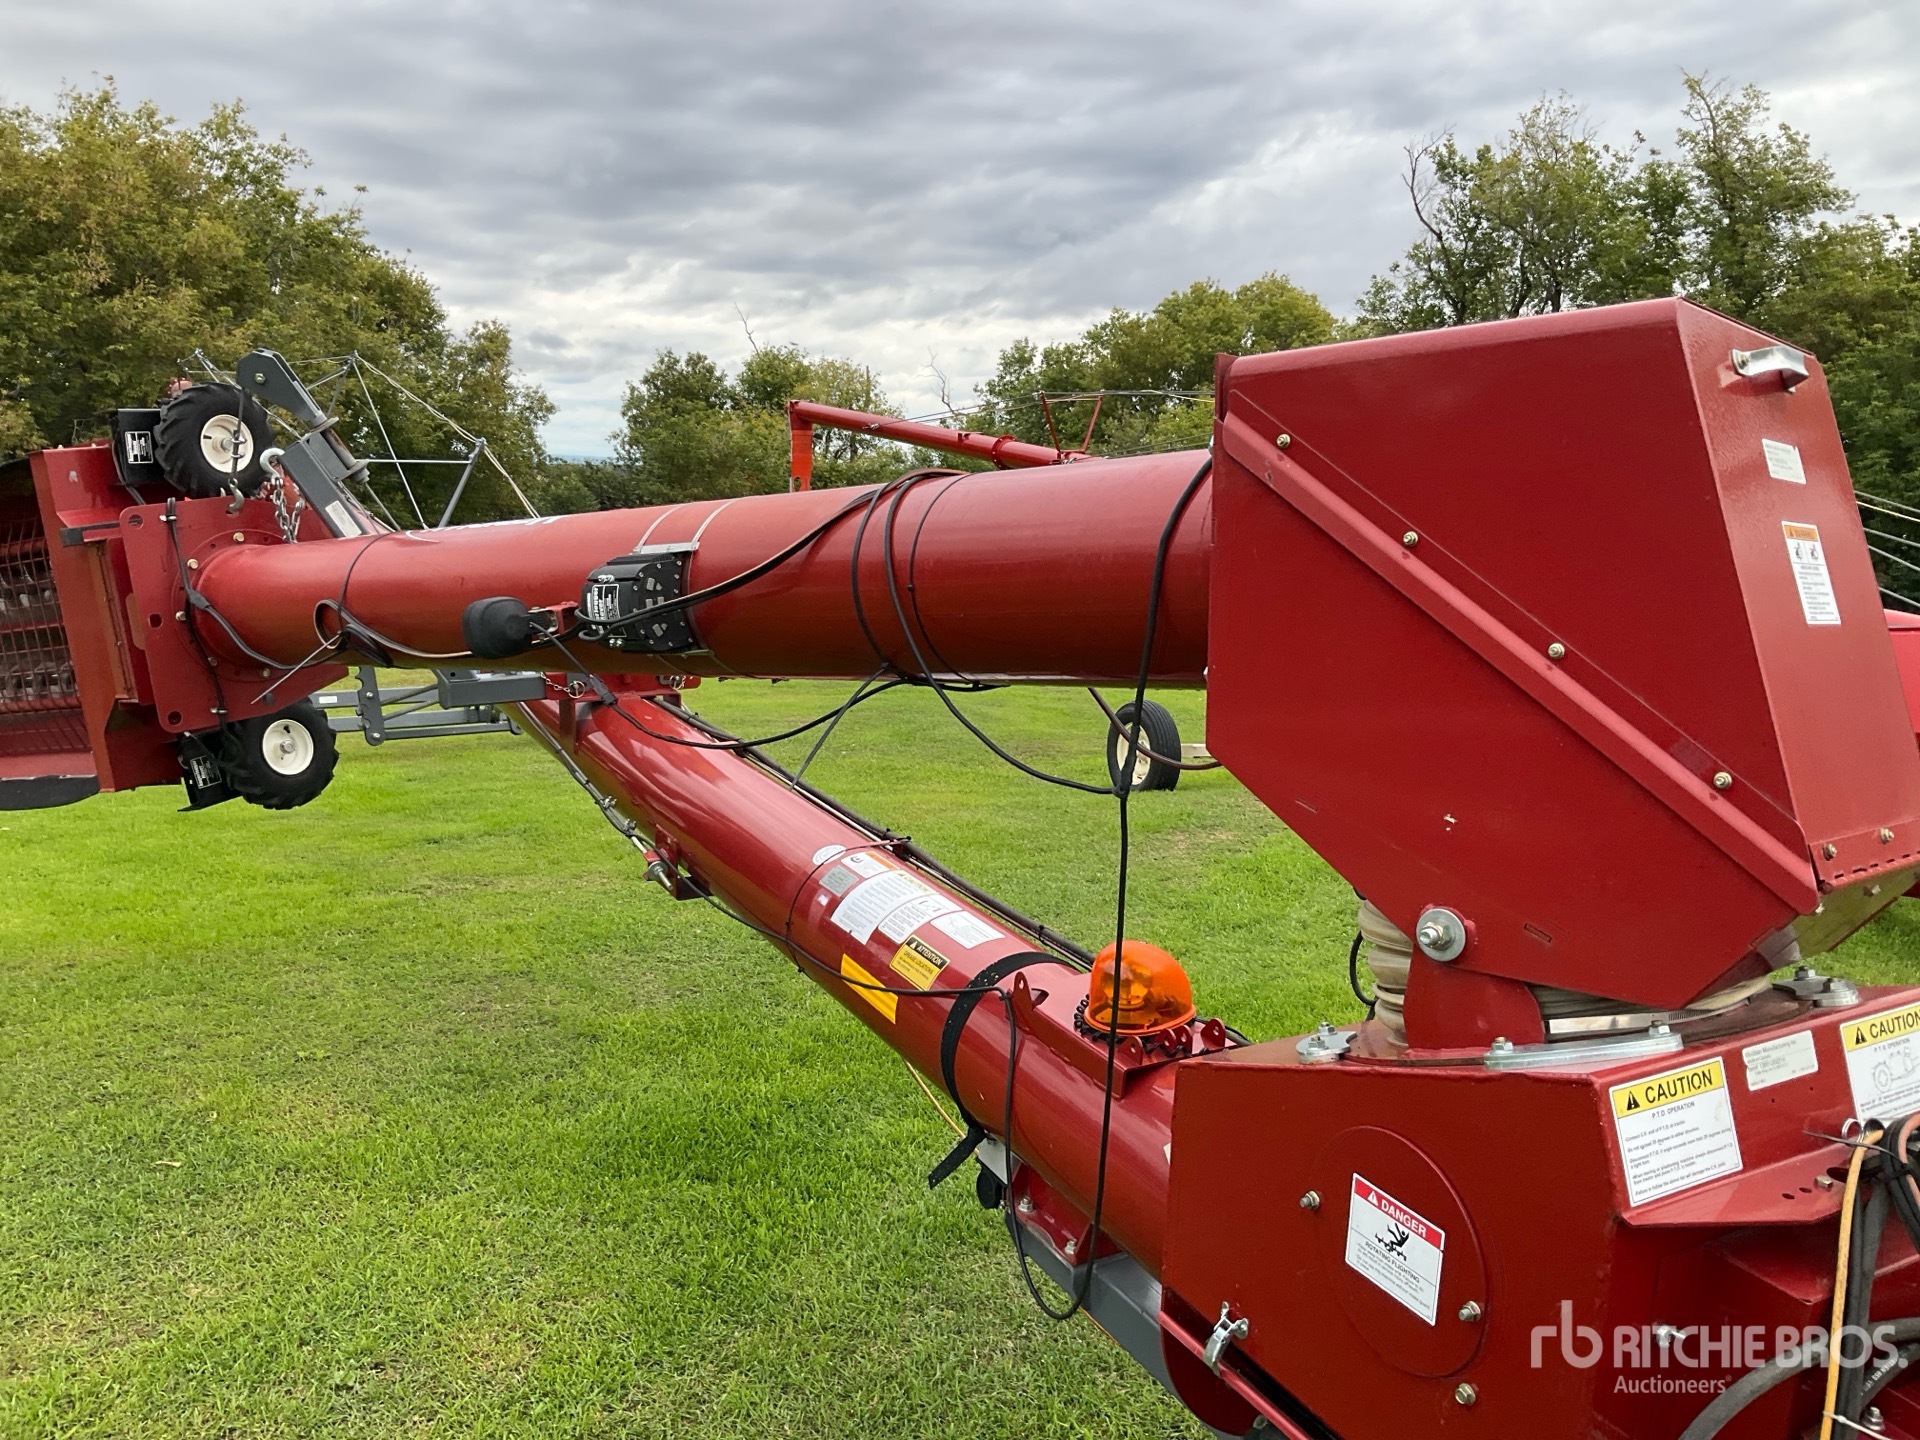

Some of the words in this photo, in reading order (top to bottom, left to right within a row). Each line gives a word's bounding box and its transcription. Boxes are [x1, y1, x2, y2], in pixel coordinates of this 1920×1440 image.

[915, 958, 933, 974] LOCATIONS
[916, 943, 943, 966] ATTENTION
[1887, 1036, 1910, 1049] OPERATION
[1644, 1068, 1713, 1104] CAUTION
[1667, 1100, 1694, 1114] OPERATION
[1380, 1198, 1426, 1238] DANGER
[1365, 1240, 1390, 1263] ROTATING
[1391, 1258, 1419, 1283] FLIGHTING
